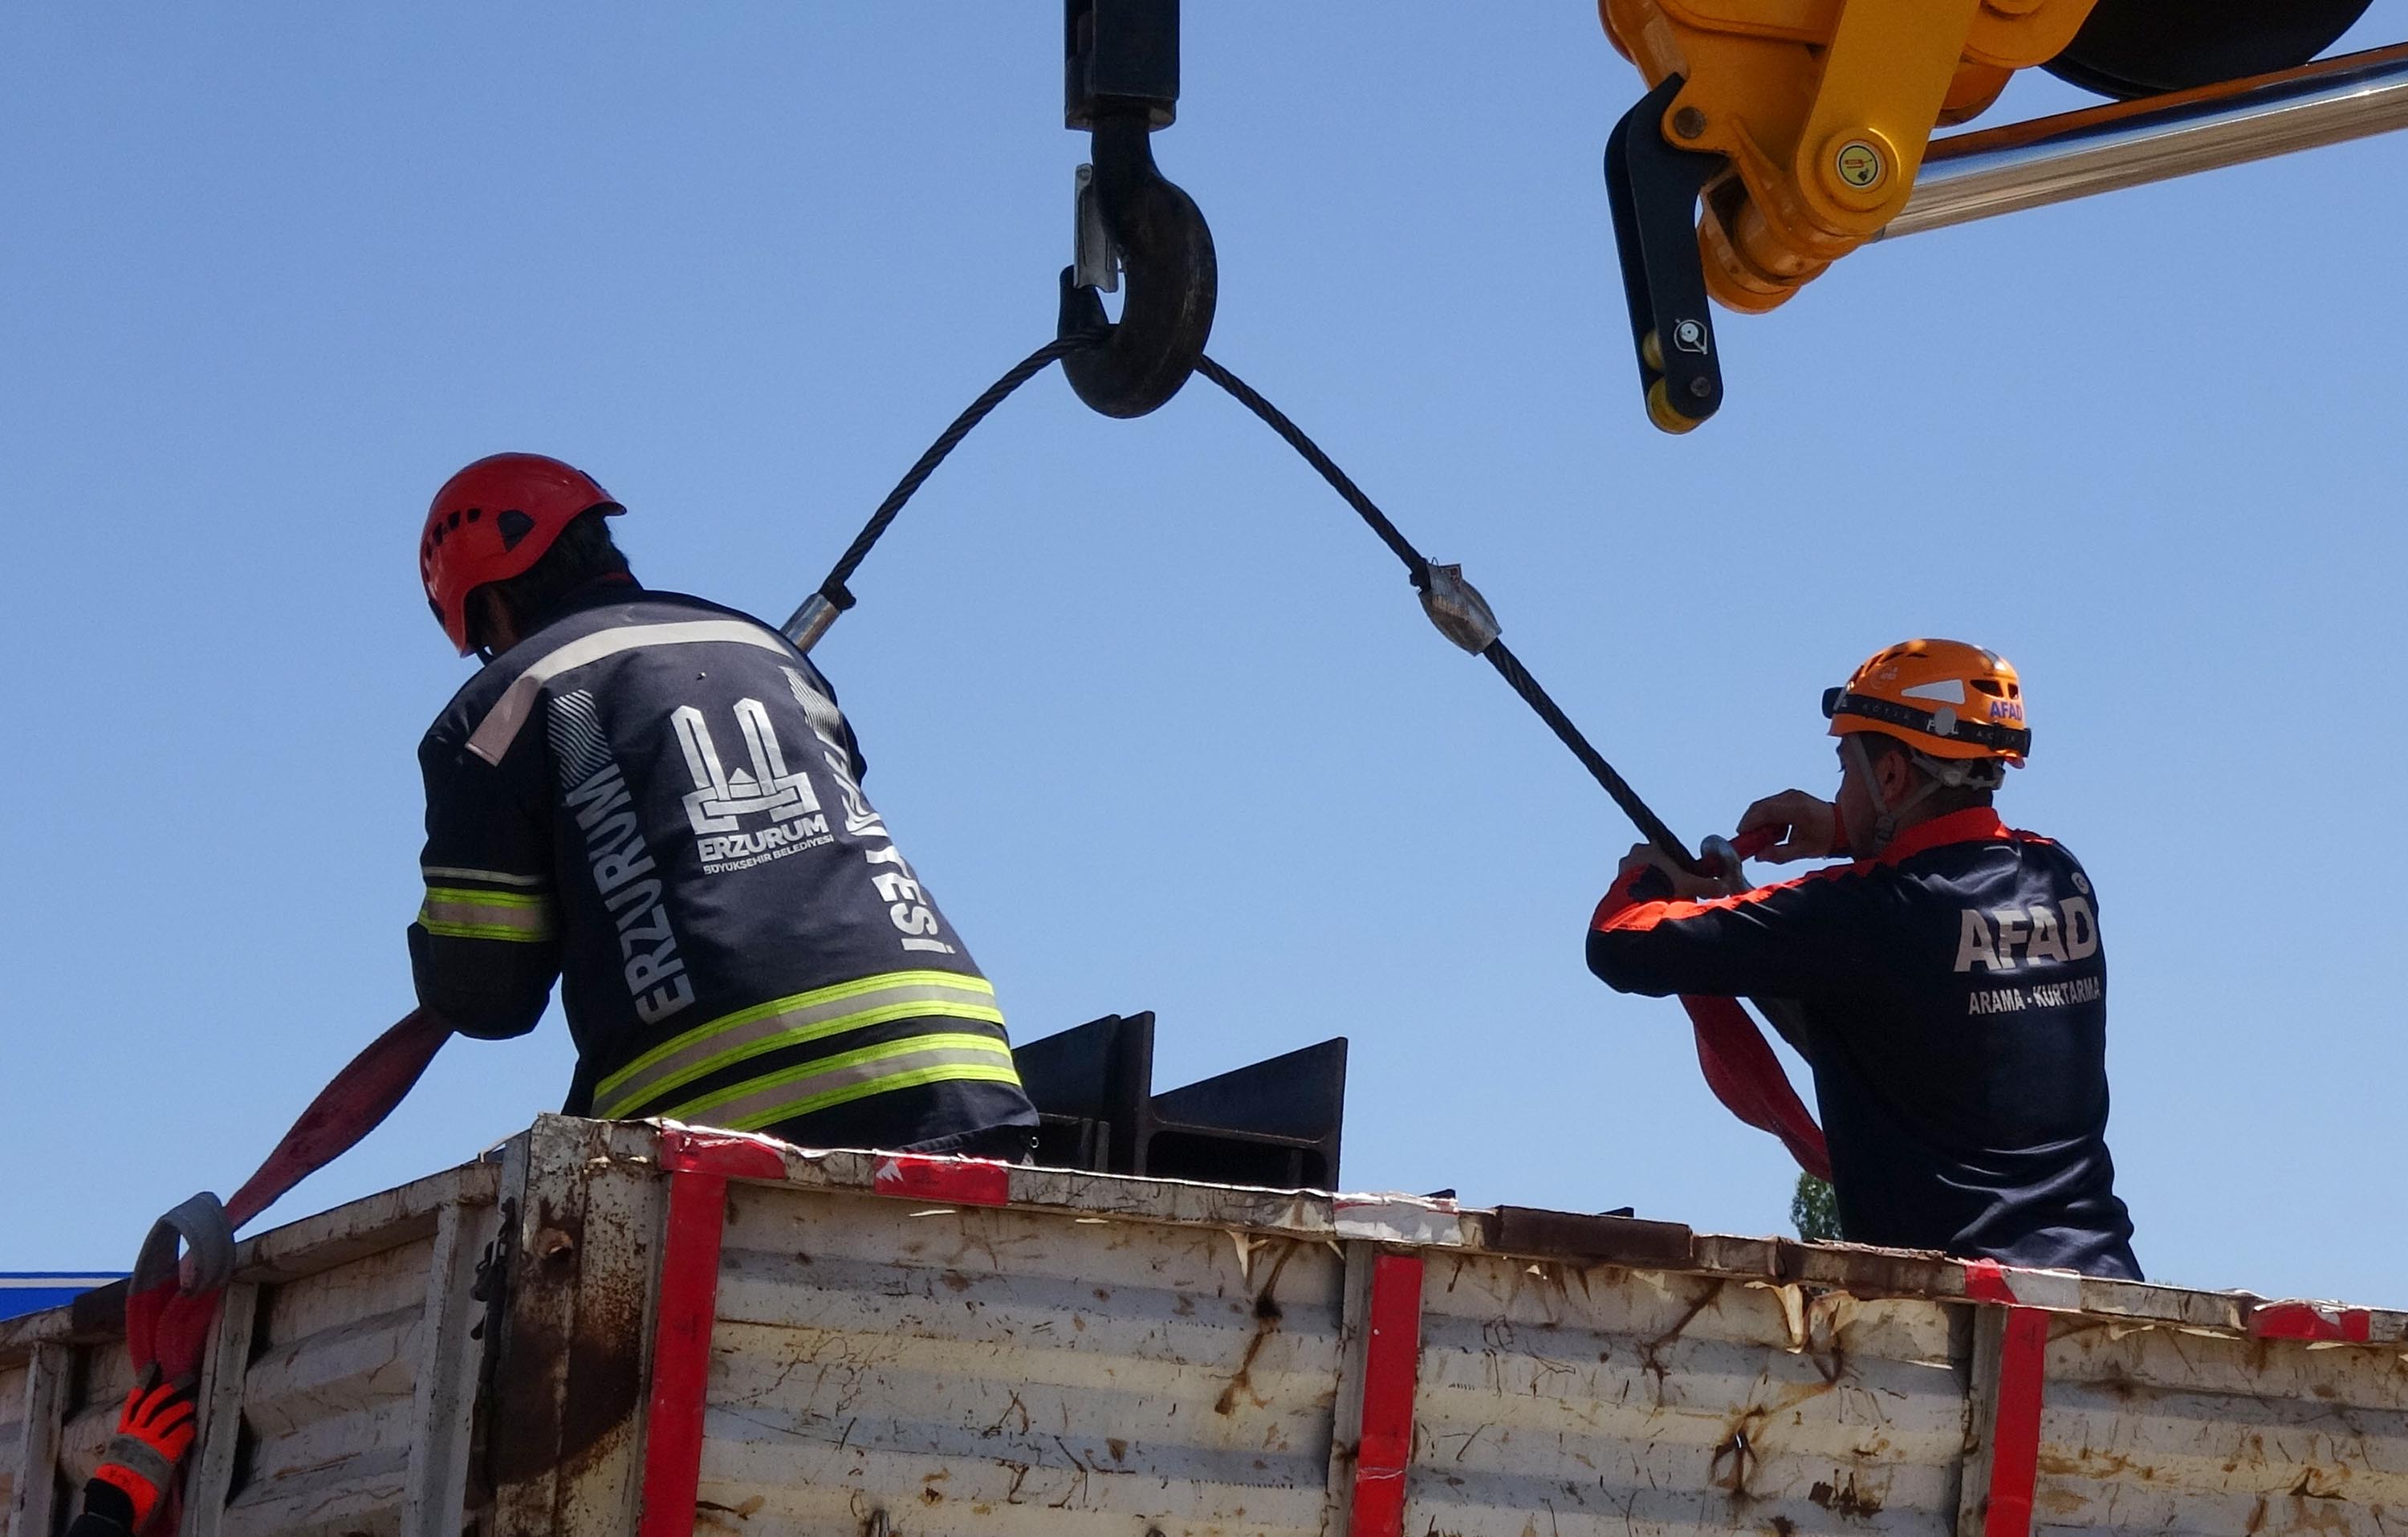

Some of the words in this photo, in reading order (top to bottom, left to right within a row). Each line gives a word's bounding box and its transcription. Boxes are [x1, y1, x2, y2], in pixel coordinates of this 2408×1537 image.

[1990, 701, 2023, 721] AFAD
[697, 813, 830, 863] ERZURUM
[565, 762, 696, 1026] ERZURUM
[1953, 896, 2097, 973] AFAD
[1968, 988, 2026, 1015] ARAMA
[2032, 976, 2101, 1008] KURTARMA
